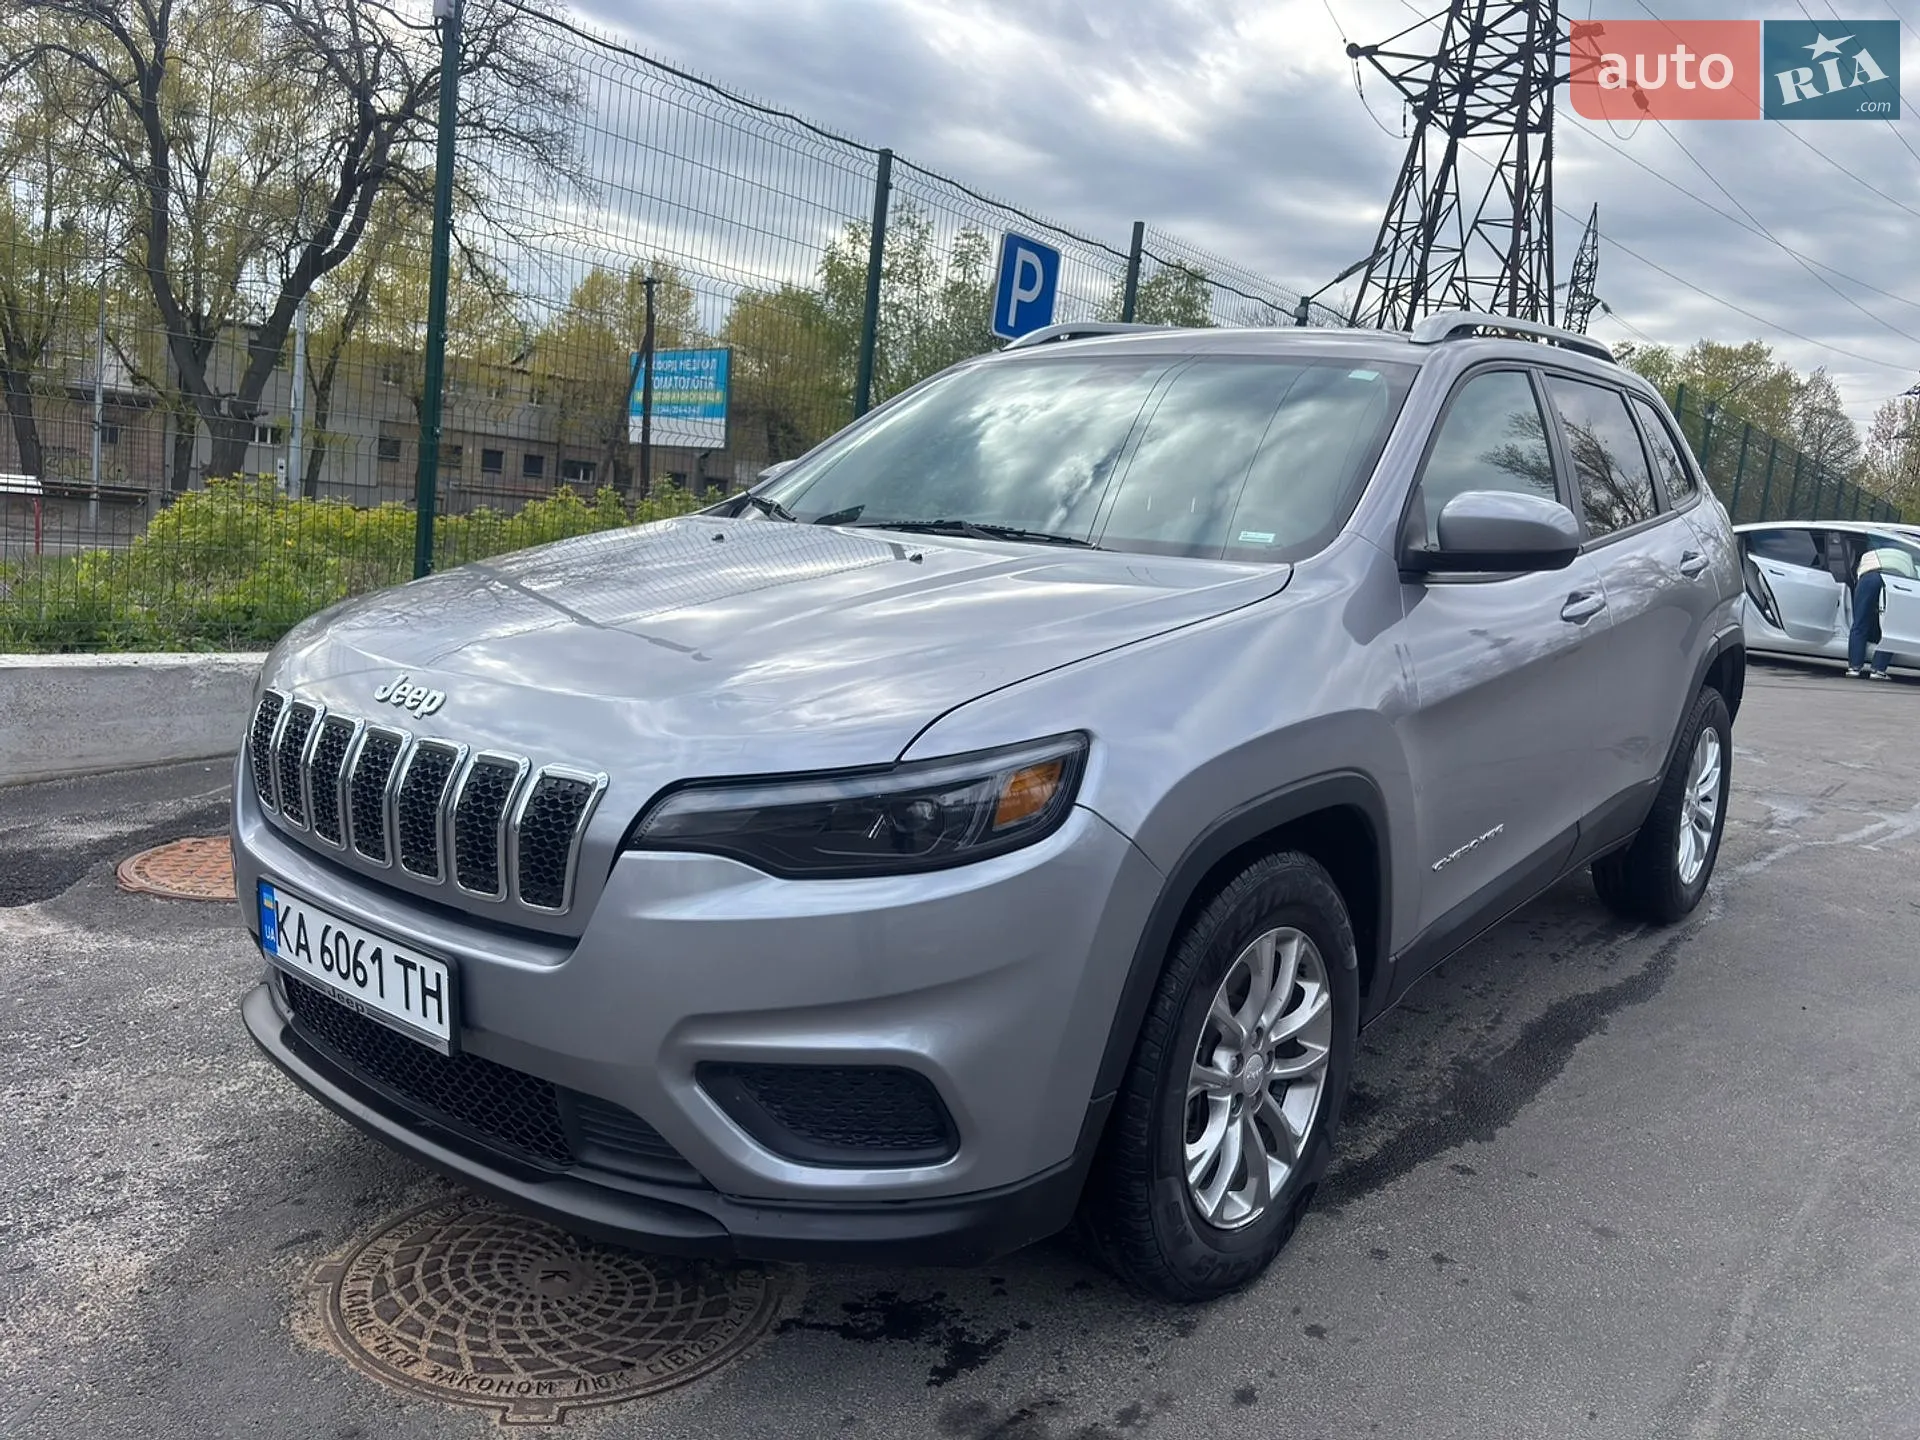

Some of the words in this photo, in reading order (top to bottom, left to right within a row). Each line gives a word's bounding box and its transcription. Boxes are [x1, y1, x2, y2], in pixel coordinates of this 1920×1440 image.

[1008, 246, 1043, 328] P
[374, 673, 447, 720] Jeep
[264, 924, 276, 943] UA
[276, 900, 312, 964] KA
[320, 924, 385, 998] 6061
[394, 954, 443, 1025] TH
[423, 1365, 554, 1395] ЗАКОНОМ
